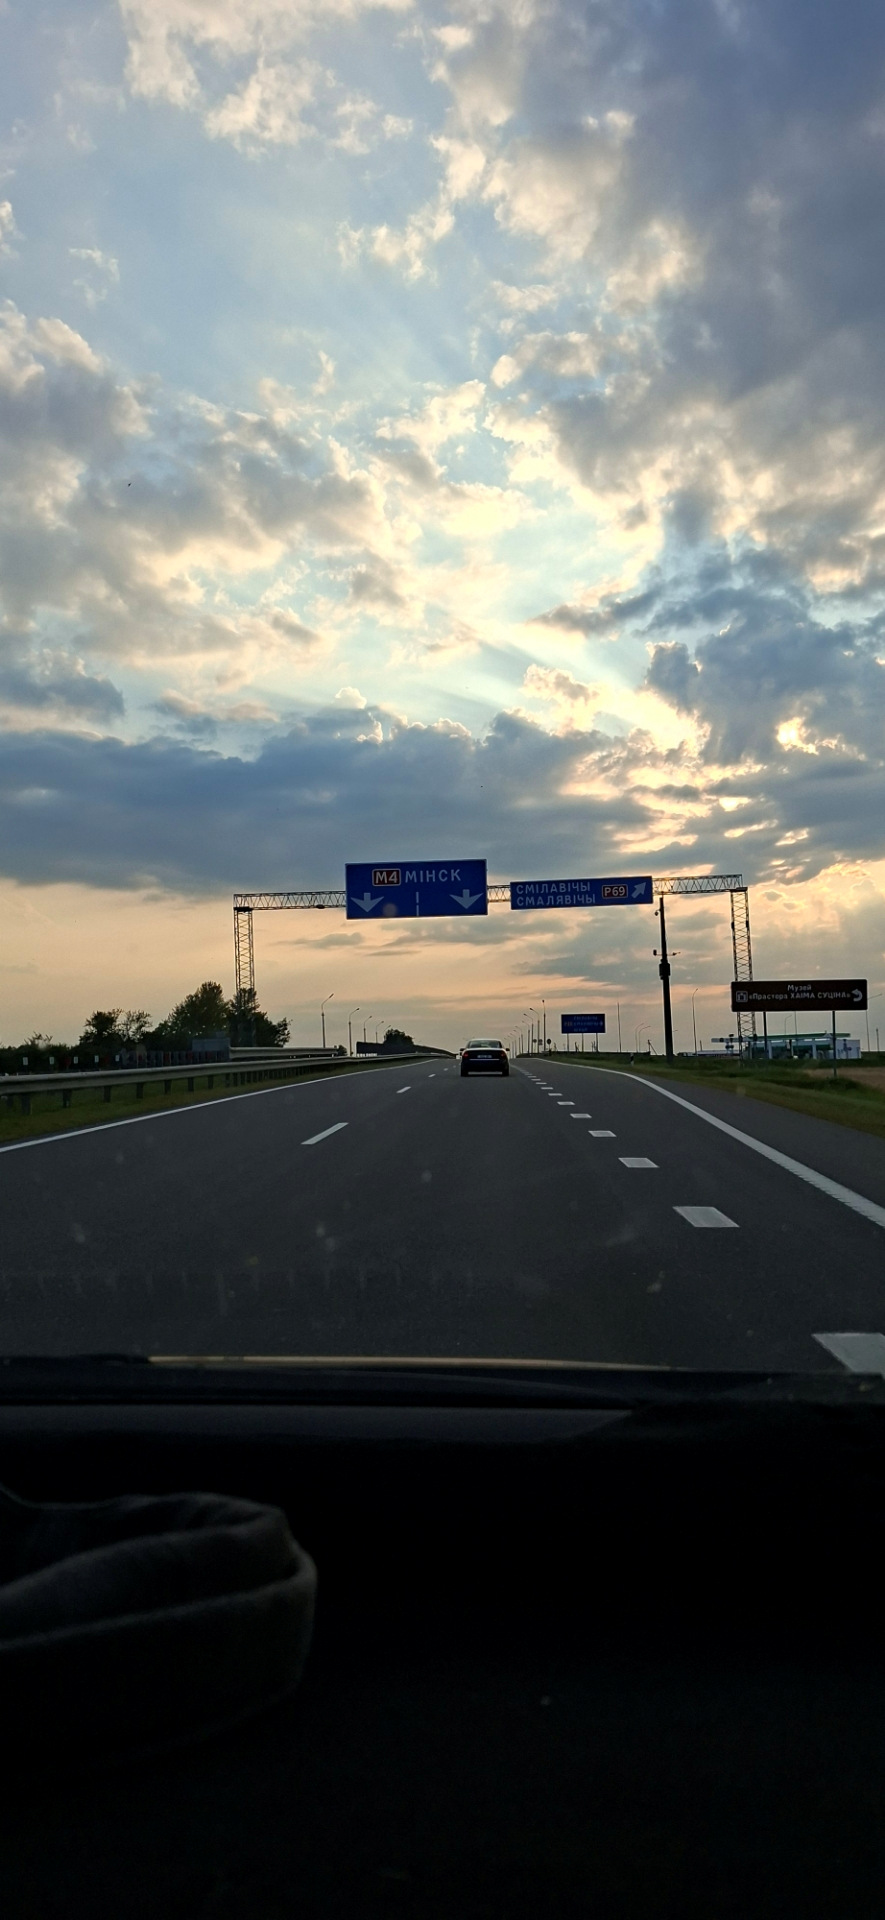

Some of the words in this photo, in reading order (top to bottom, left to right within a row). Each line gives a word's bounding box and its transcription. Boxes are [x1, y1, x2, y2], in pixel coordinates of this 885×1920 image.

[375, 871, 398, 884] М4
[405, 869, 461, 883] МІНСК
[516, 882, 590, 895] СМІЛАВІЧЫ
[604, 886, 626, 897] Р69
[516, 894, 595, 907] СМАЛЯВІЧЫ
[787, 984, 812, 992] Музей
[790, 991, 815, 999] ХАІМА
